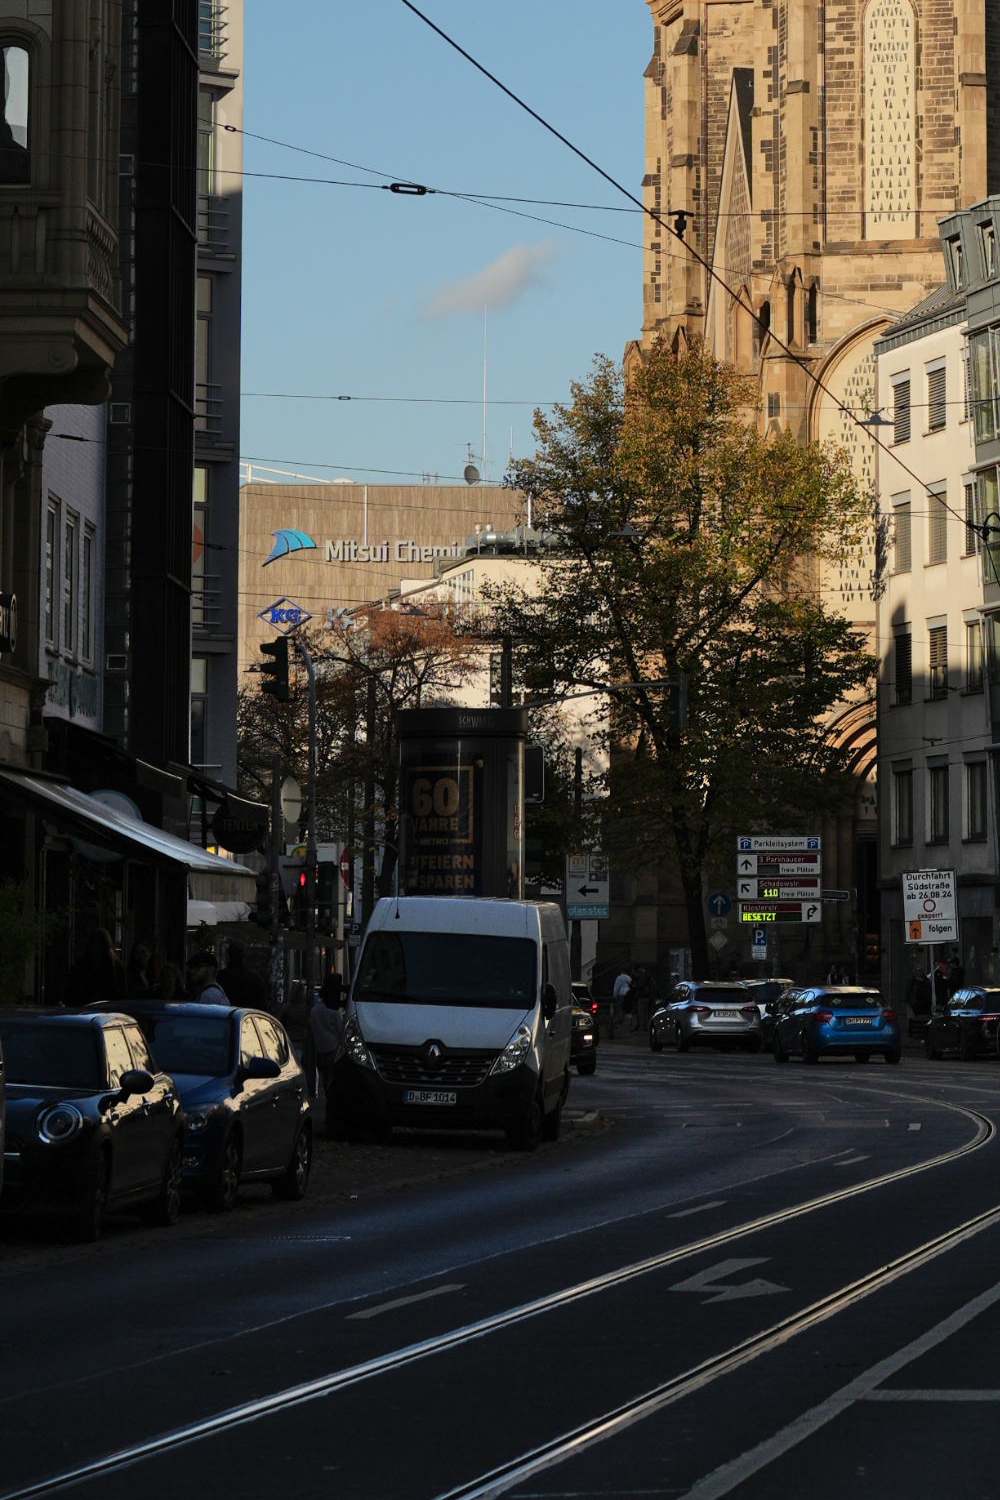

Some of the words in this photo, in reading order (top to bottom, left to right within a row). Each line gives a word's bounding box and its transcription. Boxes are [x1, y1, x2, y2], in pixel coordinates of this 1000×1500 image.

[326, 540, 390, 562] Mitsui
[270, 607, 301, 623] KG
[412, 777, 459, 817] 60
[222, 819, 259, 831] TENTEN
[754, 840, 805, 849] Parkleitsystem
[416, 854, 475, 870] TFEIERN
[419, 874, 475, 889] SPAREN
[906, 873, 951, 881] Durchfahrt
[759, 880, 801, 888] Schadowstr.
[907, 882, 951, 891] Südstraße
[763, 888, 779, 898] 110
[918, 891, 952, 900] 26.08.24
[568, 906, 608, 917] glasstec
[918, 912, 943, 920] gesperrt
[742, 912, 777, 922] BESETZT
[928, 924, 953, 934] folgen
[755, 929, 764, 944] P
[409, 1092, 415, 1101] D
[420, 1092, 432, 1102] BF
[433, 1093, 456, 1103] 1014
